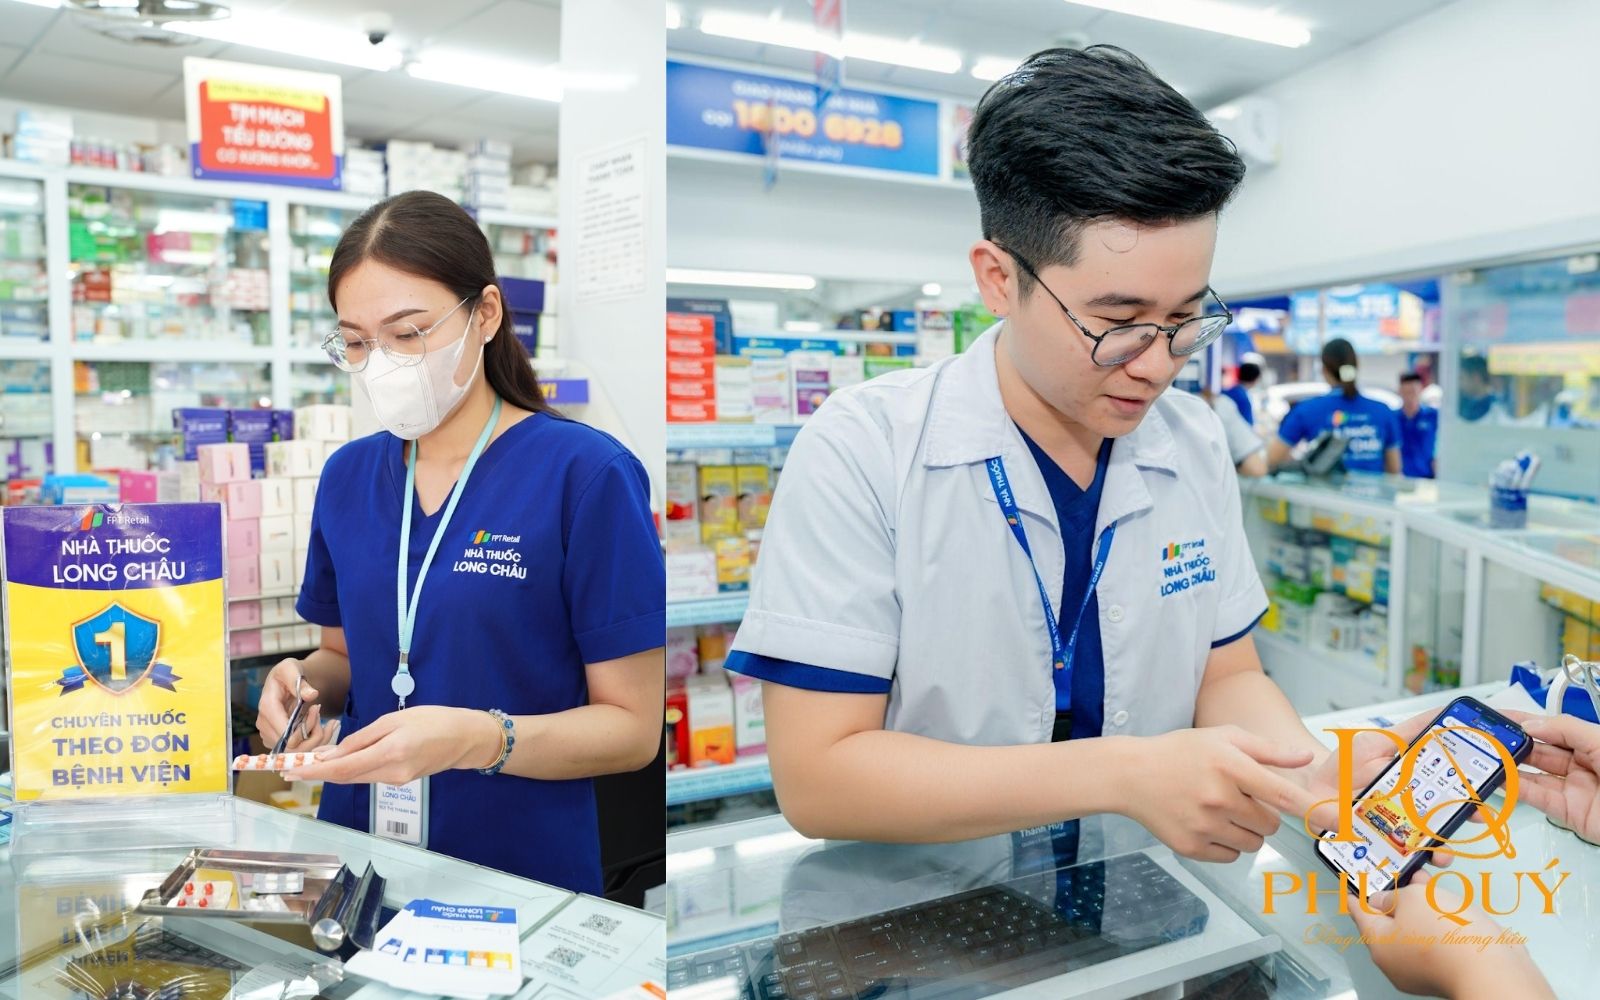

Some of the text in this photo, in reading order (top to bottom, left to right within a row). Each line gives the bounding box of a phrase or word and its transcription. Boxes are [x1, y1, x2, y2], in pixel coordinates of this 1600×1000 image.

[124, 514, 150, 525] Retail
[61, 532, 171, 556] NHÀ THUỐC
[491, 534, 520, 544] FPT Retail
[464, 546, 521, 563] NHÀ THUỐC
[1164, 551, 1210, 578] NHÀ THUỐC
[53, 558, 187, 583] LONG CHÂU
[453, 561, 528, 580] LONG CHÂU
[1161, 578, 1190, 597] LONG
[94, 621, 127, 681] 1
[51, 708, 187, 729] CHUYÊN THUỐC
[52, 731, 189, 757] THEO ĐƠN
[52, 760, 191, 790] BỆNH VIỆN
[430, 905, 457, 913] CHÂU
[463, 907, 484, 915] LONG
